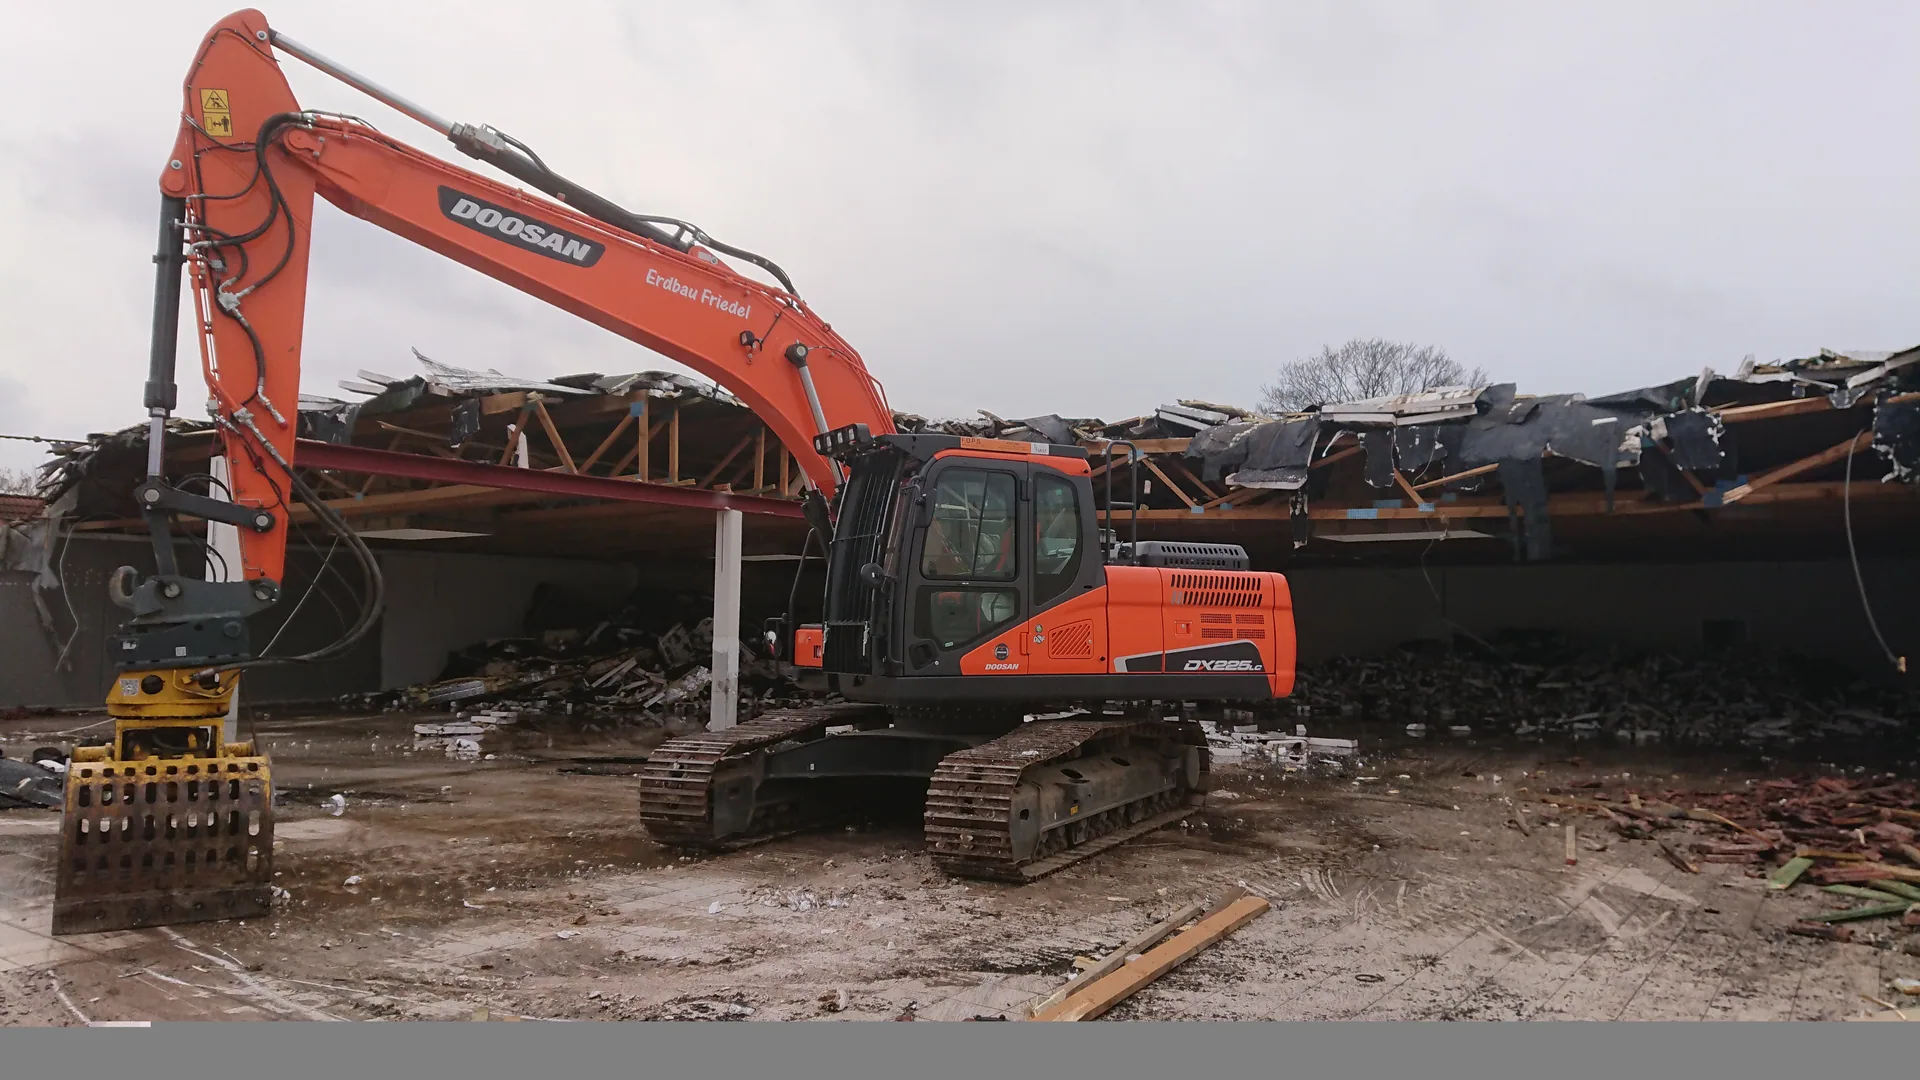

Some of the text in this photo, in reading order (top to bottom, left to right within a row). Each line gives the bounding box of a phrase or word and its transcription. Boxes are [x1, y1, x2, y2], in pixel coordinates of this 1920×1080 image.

[450, 198, 591, 261] DOOSAN
[645, 268, 751, 319] Erdbau Friedel
[985, 663, 1020, 671] DOOSAN
